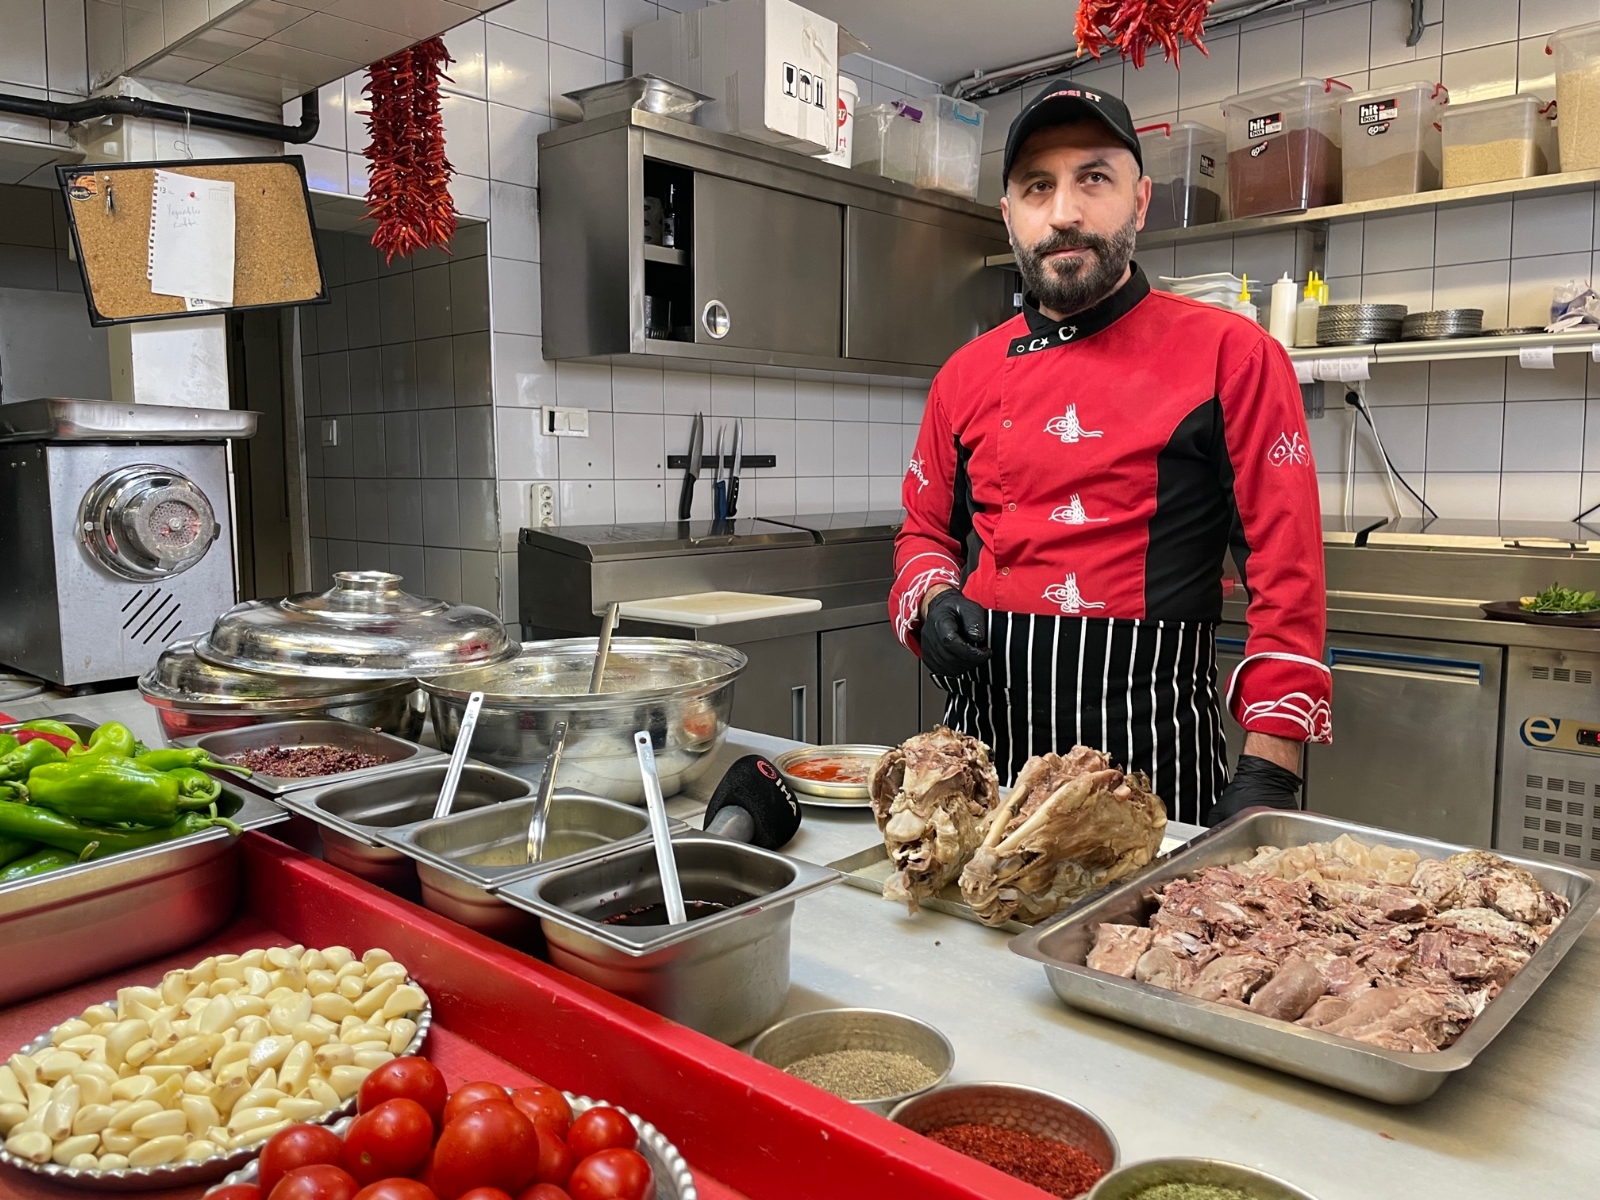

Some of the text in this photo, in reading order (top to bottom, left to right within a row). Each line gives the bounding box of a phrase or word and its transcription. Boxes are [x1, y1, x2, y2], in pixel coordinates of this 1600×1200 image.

[1085, 91, 1102, 102] ET
[1361, 104, 1379, 117] hit
[1250, 118, 1265, 132] hit
